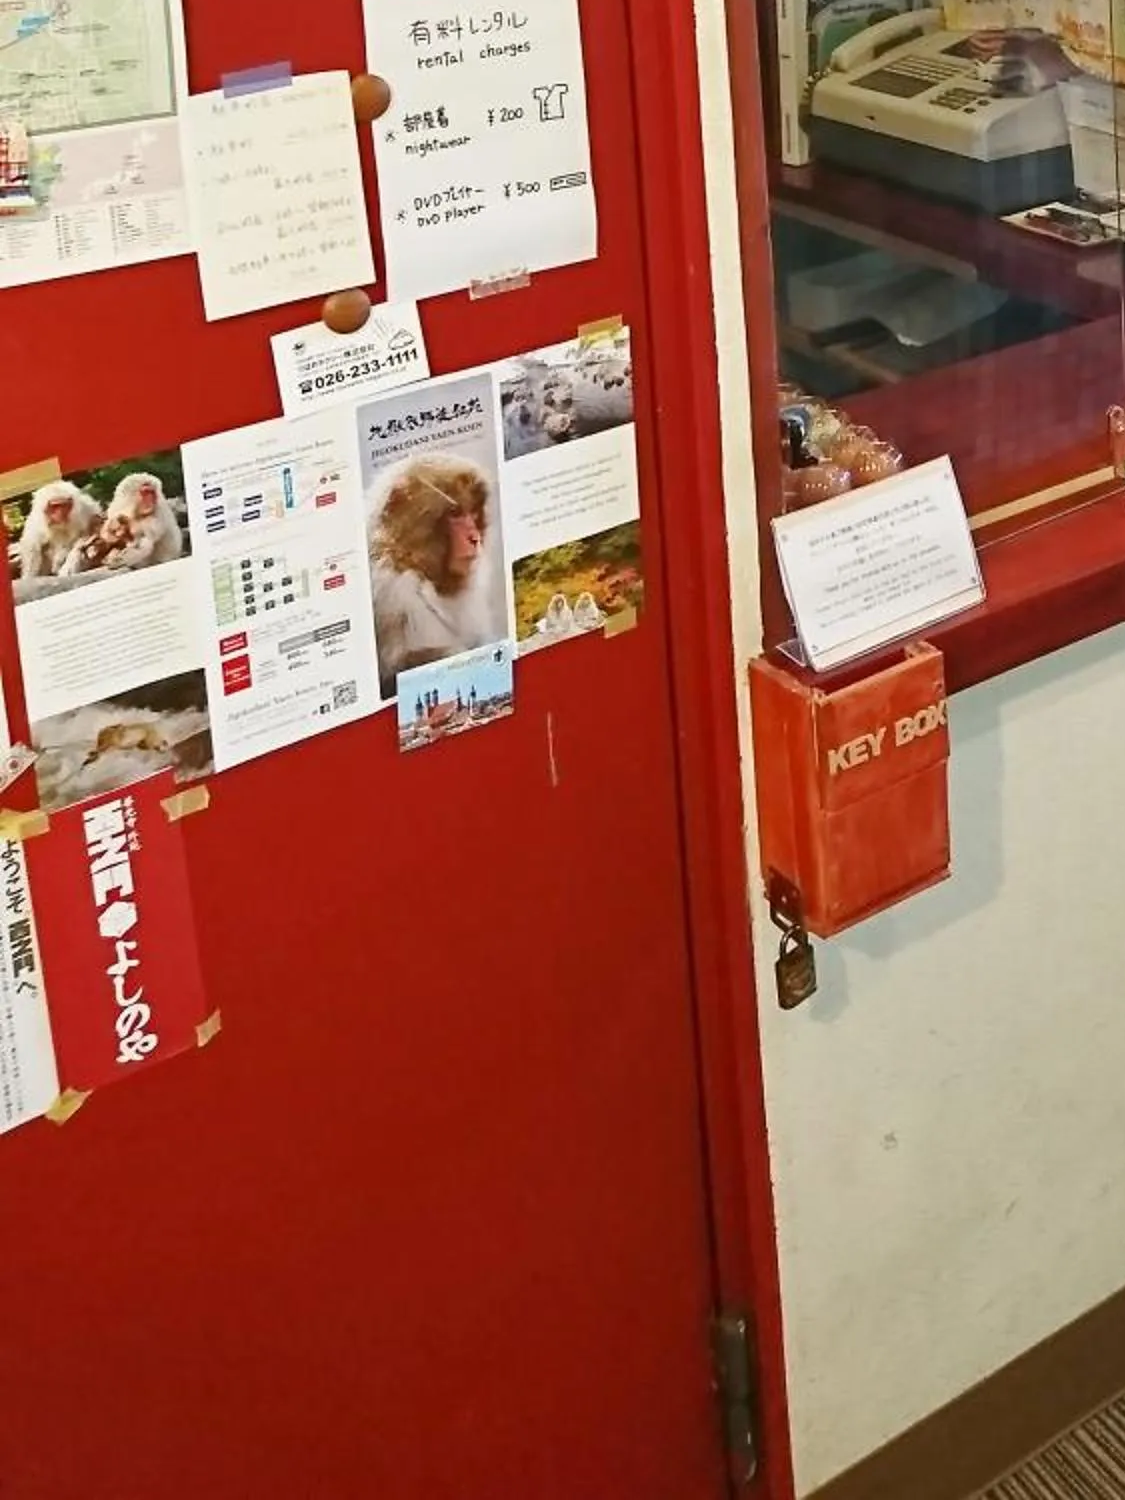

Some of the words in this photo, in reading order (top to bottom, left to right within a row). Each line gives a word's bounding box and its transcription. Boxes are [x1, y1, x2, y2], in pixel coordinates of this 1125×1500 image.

[408, 11, 529, 46] 有料レンタル
[417, 50, 464, 69] rental
[479, 41, 532, 60] charges
[405, 136, 472, 157] nightwear
[417, 212, 440, 227] DVD
[315, 348, 419, 389] 026-233-1111
[827, 726, 885, 776] KEY
[895, 700, 948, 747] BOX
[106, 940, 159, 1063] よしのや
